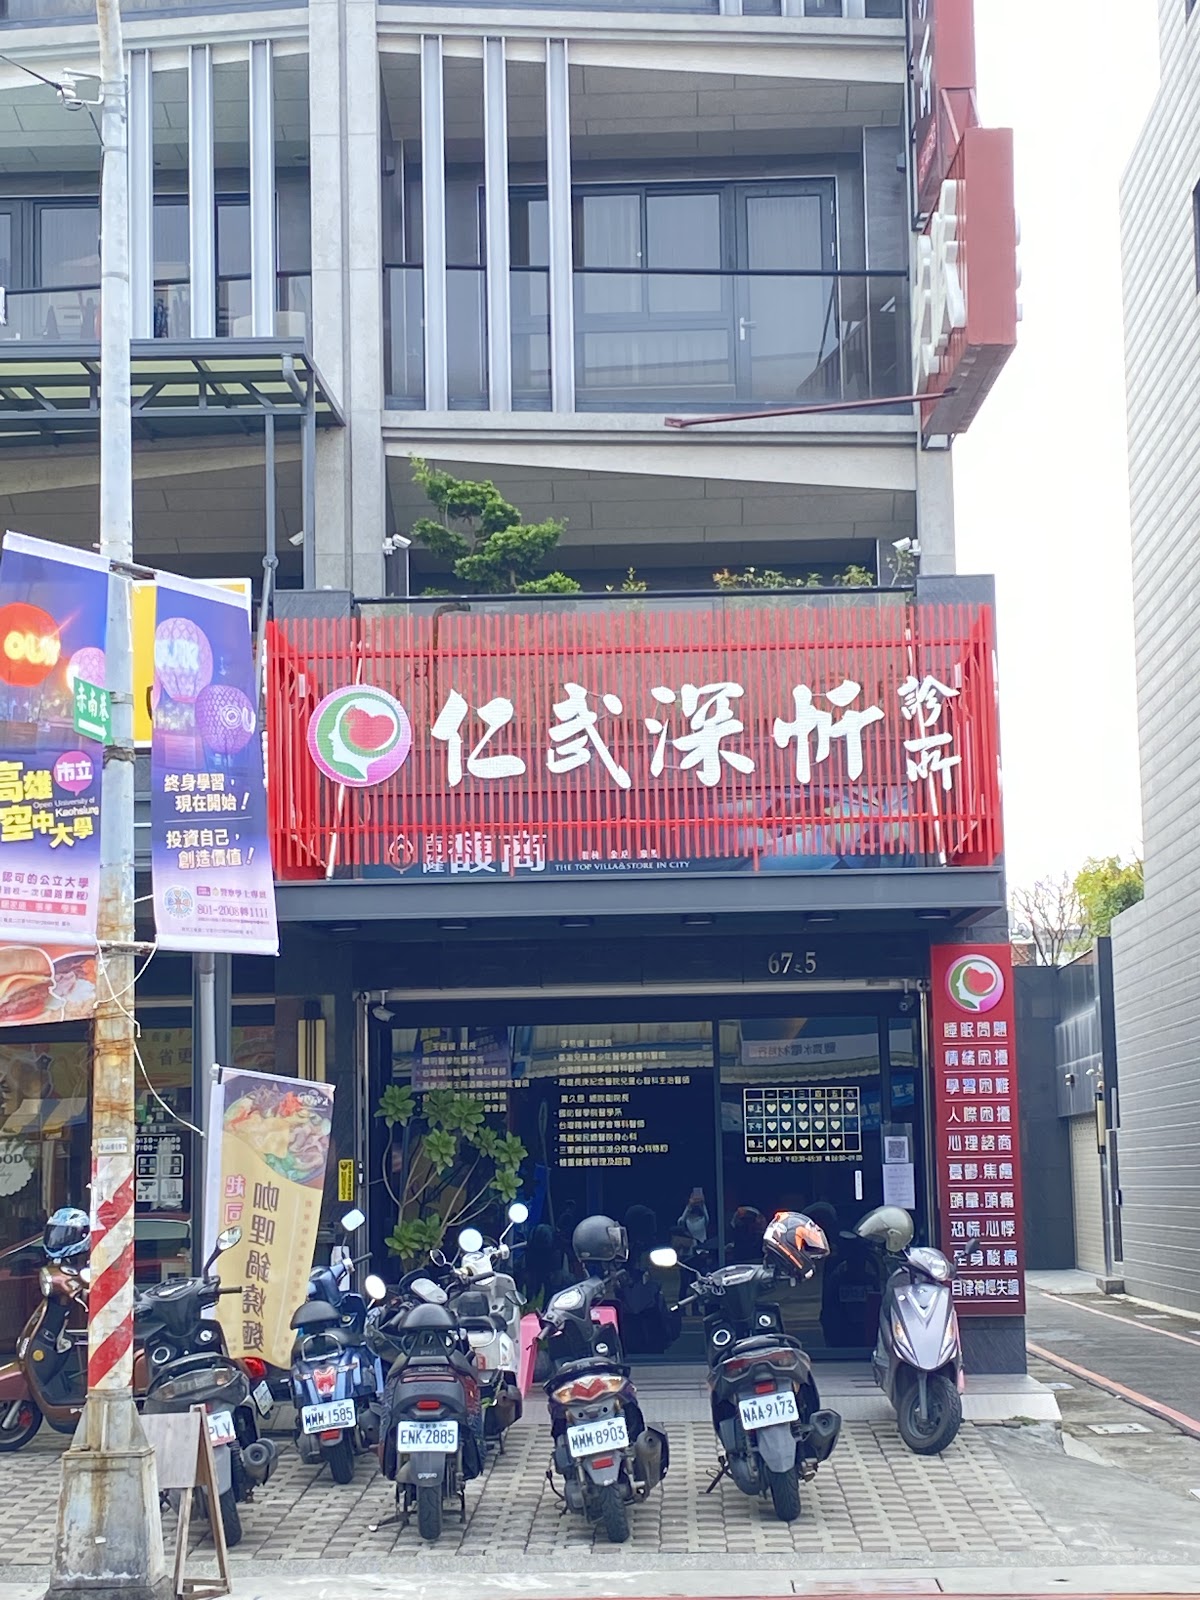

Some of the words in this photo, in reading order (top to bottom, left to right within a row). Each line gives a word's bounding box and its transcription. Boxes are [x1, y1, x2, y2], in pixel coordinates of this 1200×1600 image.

[431, 679, 885, 789] 仁武深忻
[897, 675, 961, 792] 診所
[56, 760, 93, 783] 市立
[0, 761, 53, 803] 高雄
[55, 806, 99, 817] Kaohsiung
[1, 806, 94, 848] 空中大學
[669, 861, 691, 869] CITY
[3, 871, 89, 889] 認可的公立大學
[944, 1021, 1007, 1038] 睡眠問題
[945, 1049, 1008, 1066] 情緒困擾
[946, 1077, 1010, 1095] 學習困難
[947, 1106, 1011, 1123] 人際困擾
[947, 1134, 1012, 1151] 心理諮商
[951, 1279, 1020, 1296] 自律神經失調
[401, 1429, 455, 1444] ENK-2885
